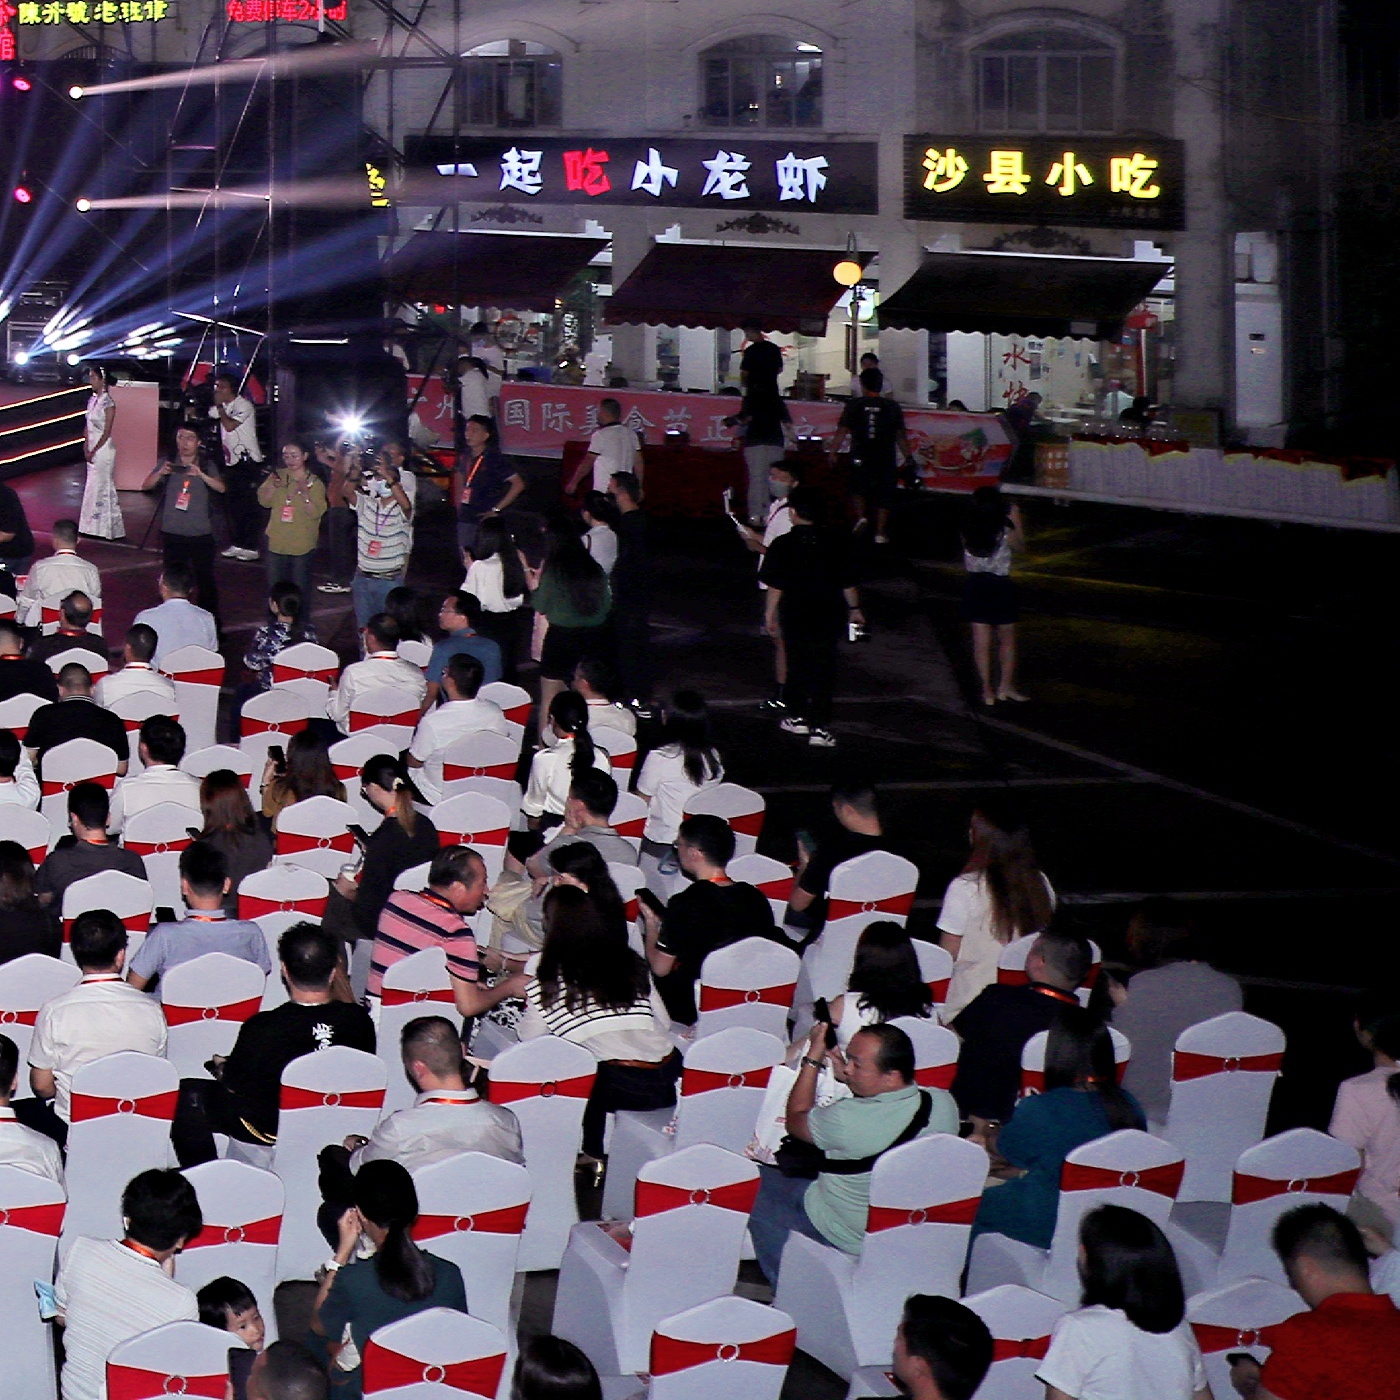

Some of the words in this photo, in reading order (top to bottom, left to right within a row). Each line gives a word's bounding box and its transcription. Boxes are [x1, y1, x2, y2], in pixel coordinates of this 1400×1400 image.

[436, 146, 830, 203] 一起吃小龙虾
[922, 148, 1161, 199] 沙县小吃
